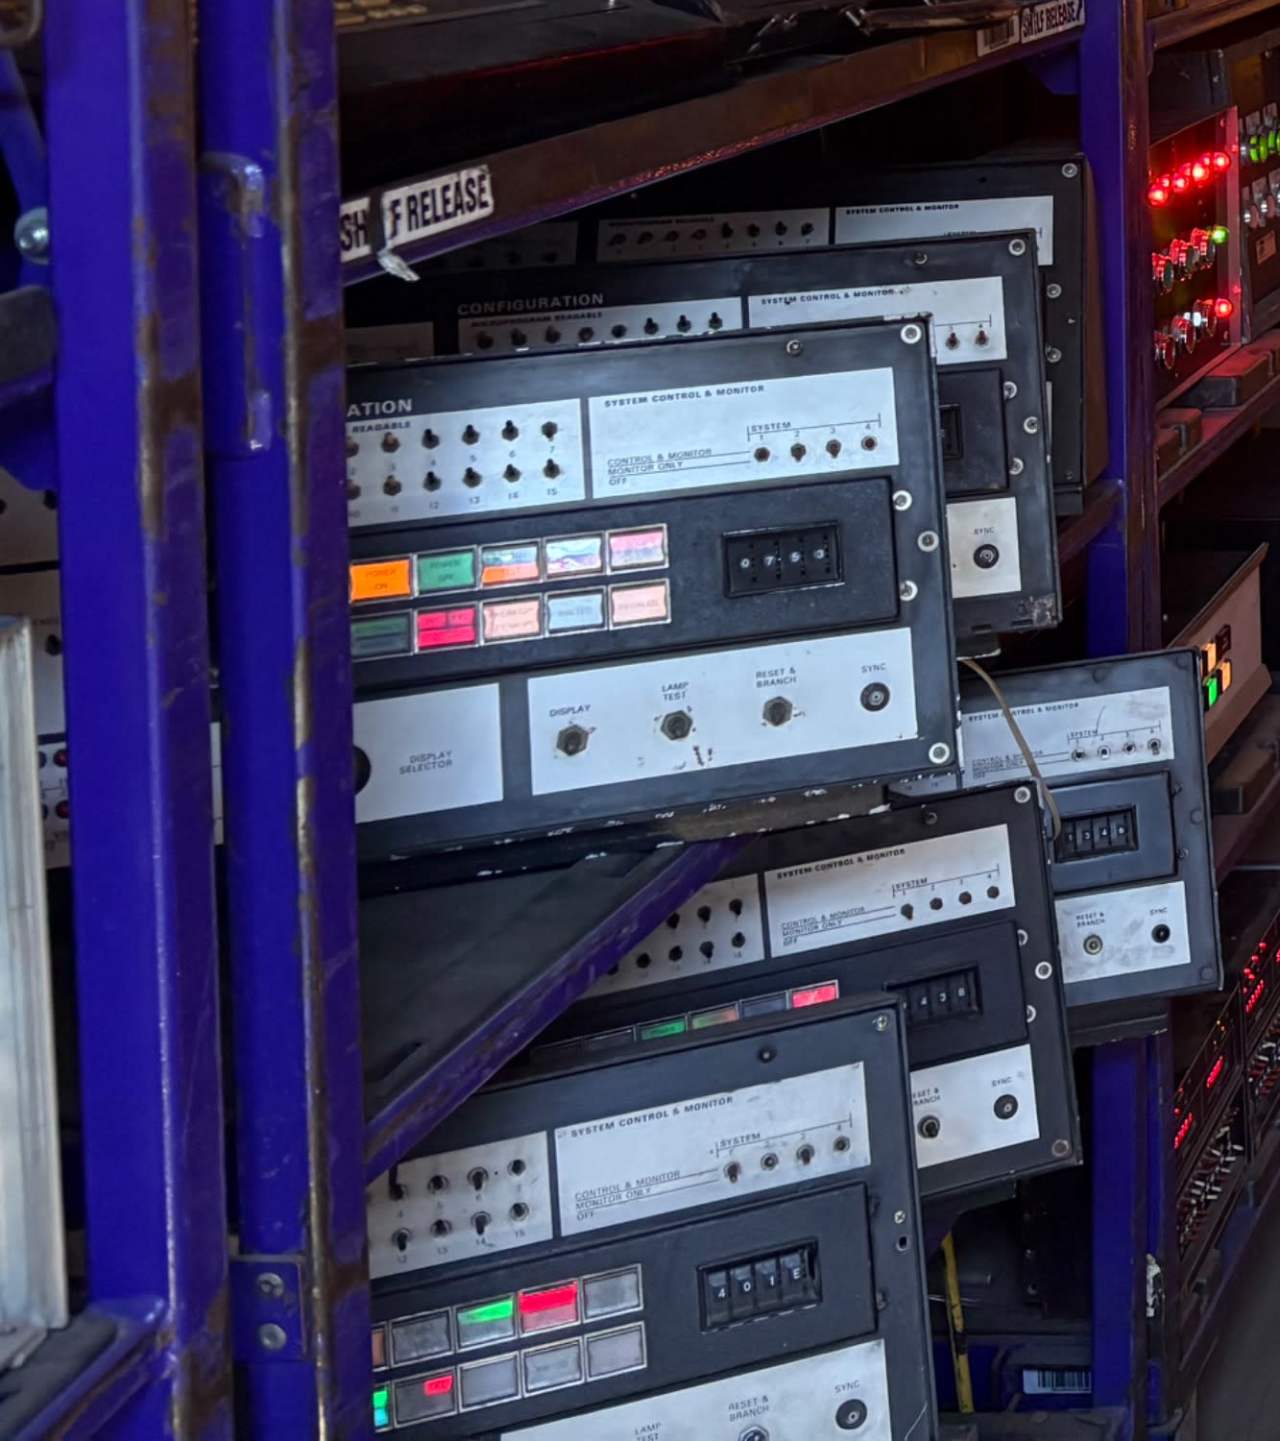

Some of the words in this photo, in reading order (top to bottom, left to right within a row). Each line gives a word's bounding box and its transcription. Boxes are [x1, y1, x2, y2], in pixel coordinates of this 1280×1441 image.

[407, 172, 490, 232] RELEASE
[879, 204, 914, 213] CONTROL
[924, 202, 960, 211] MONITOR
[761, 295, 798, 305] SYSTEM
[800, 292, 841, 302] CONTROL
[854, 288, 895, 299] MONITOR
[457, 292, 605, 317] CONFIGURATION
[604, 396, 649, 408] SYSTEM
[651, 390, 702, 403] CONTROL
[716, 384, 765, 397] MONITOR
[751, 420, 792, 433] SYSTEM
[608, 454, 652, 466] CONTROL
[668, 448, 712, 460] MONITOR
[608, 464, 655, 476] MONITOR
[657, 461, 684, 472] ONLY
[608, 477, 628, 486] OFF
[755, 668, 786, 681] RESET
[860, 661, 888, 674] SYNC
[661, 680, 690, 694] LAMP
[756, 675, 797, 689] BRANCH
[663, 690, 688, 703] TEST
[548, 703, 593, 718] DISPLAY
[409, 750, 454, 766] DISPLAY
[398, 758, 454, 776] SELECTOR
[776, 865, 813, 880] SYSTEM
[814, 858, 855, 873] CONTROL
[866, 848, 906, 863] MONITOR
[896, 877, 928, 891] SYSTEM
[991, 1076, 1013, 1088] SYNC
[570, 1122, 615, 1138] SYSTEM
[619, 1110, 668, 1127] CONTROL
[684, 1096, 733, 1112] MONITOR
[719, 1132, 761, 1148] SYSTEM
[575, 1185, 622, 1200] CONTROL
[635, 1170, 681, 1186] MONITOR
[575, 1194, 623, 1210] MONITOR
[626, 1188, 651, 1200] ONLY
[576, 1210, 597, 1222] OFF
[834, 1380, 861, 1394] SYNC
[728, 1397, 760, 1411] RESET
[729, 1405, 770, 1422] BRANCH
[634, 1421, 662, 1436] LAMP
